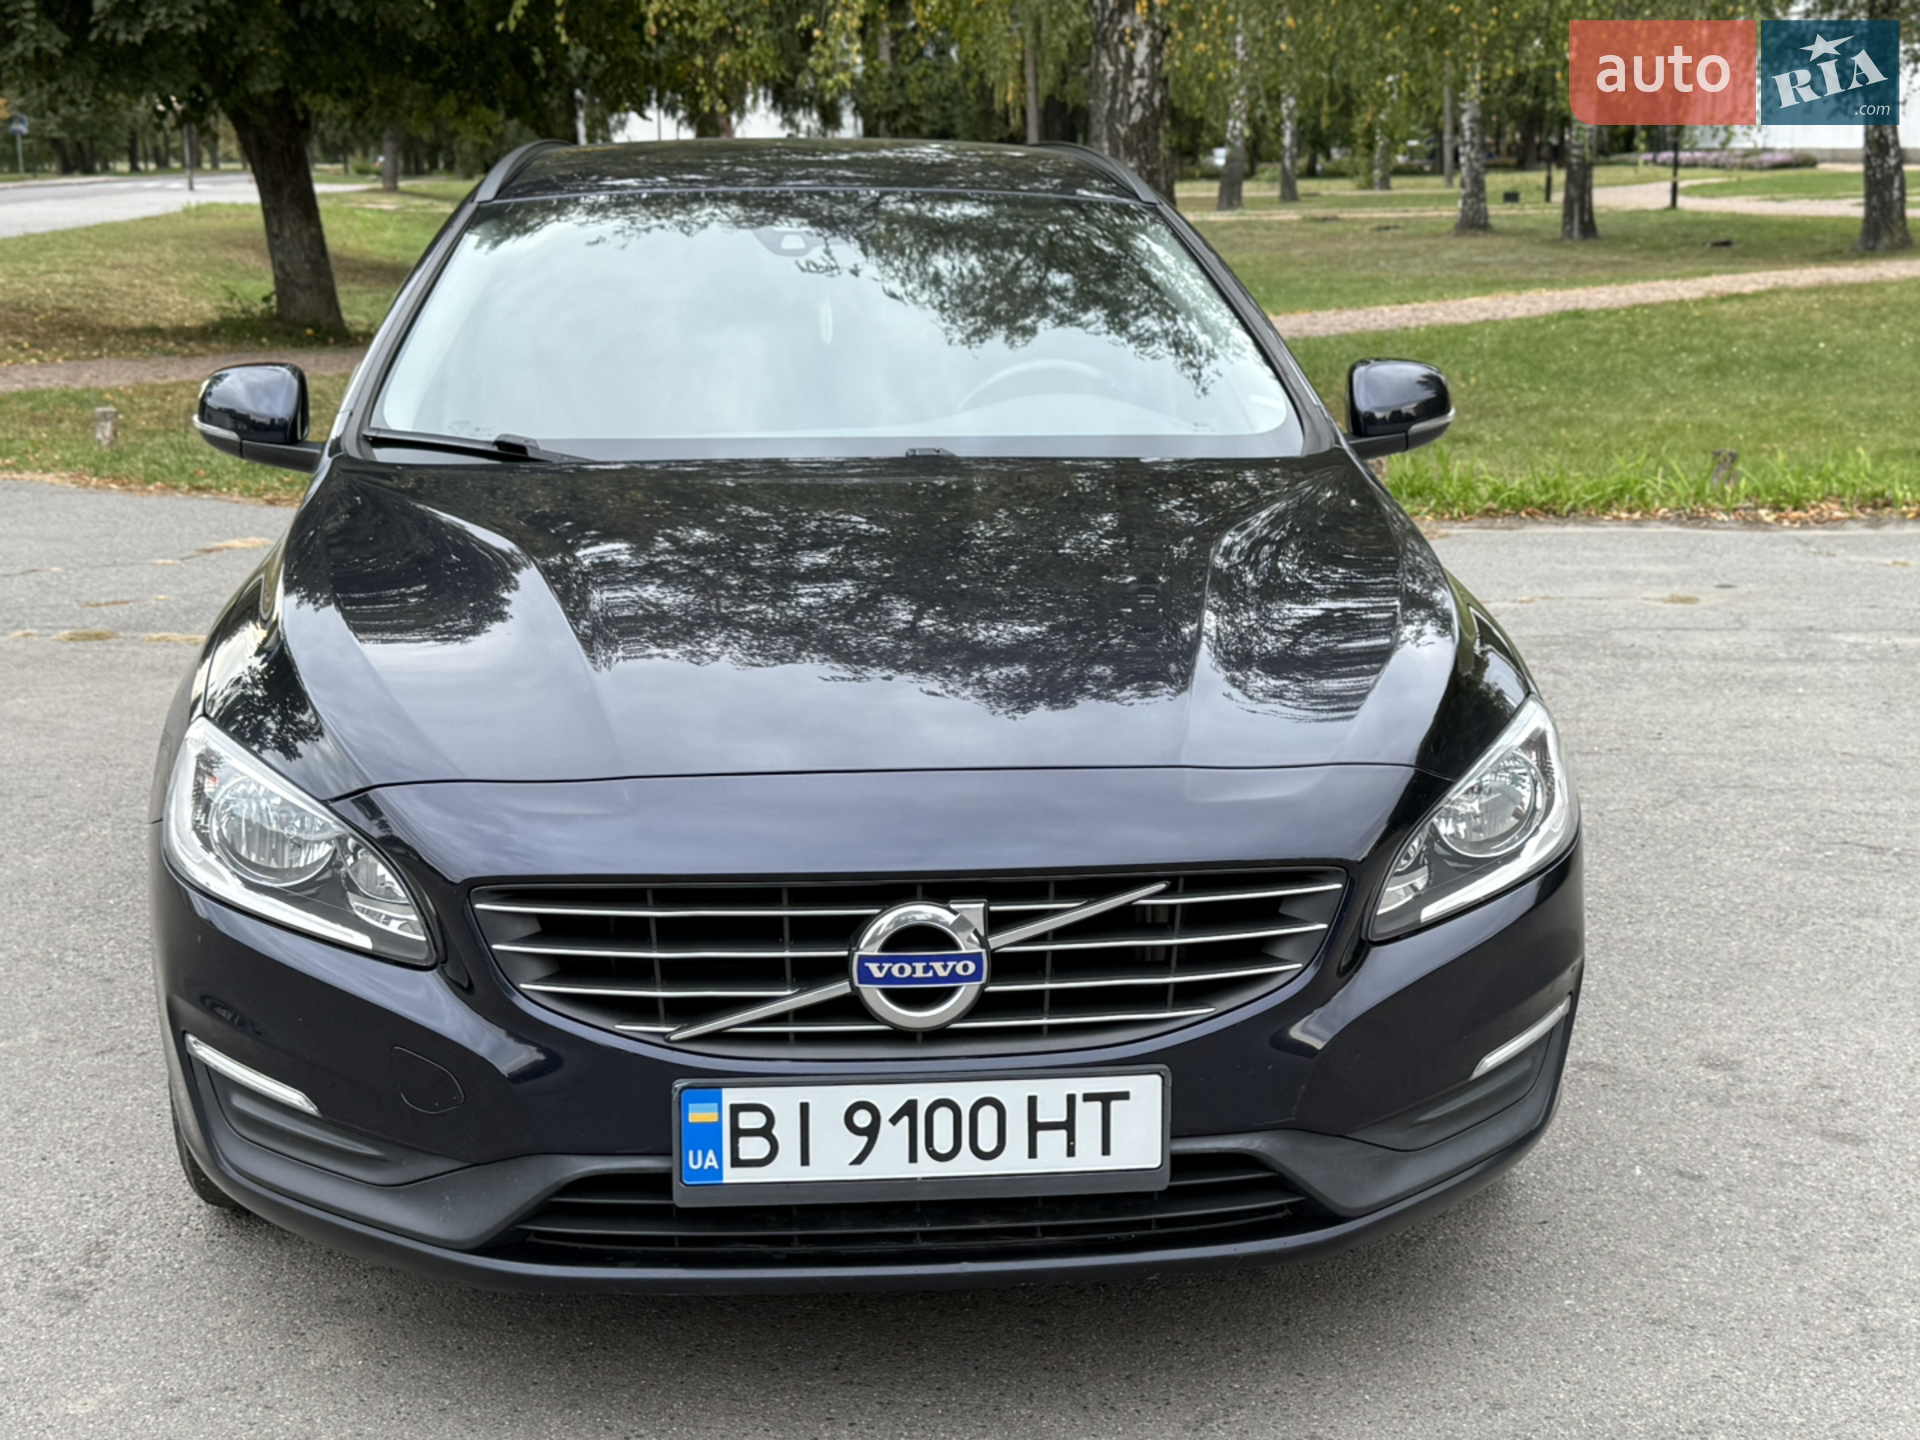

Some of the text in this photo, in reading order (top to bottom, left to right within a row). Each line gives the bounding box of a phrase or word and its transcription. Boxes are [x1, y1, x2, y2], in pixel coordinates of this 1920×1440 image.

[864, 960, 976, 978] VOLVO
[729, 1091, 1130, 1168] BI 9100 HT
[688, 1150, 719, 1170] UA
